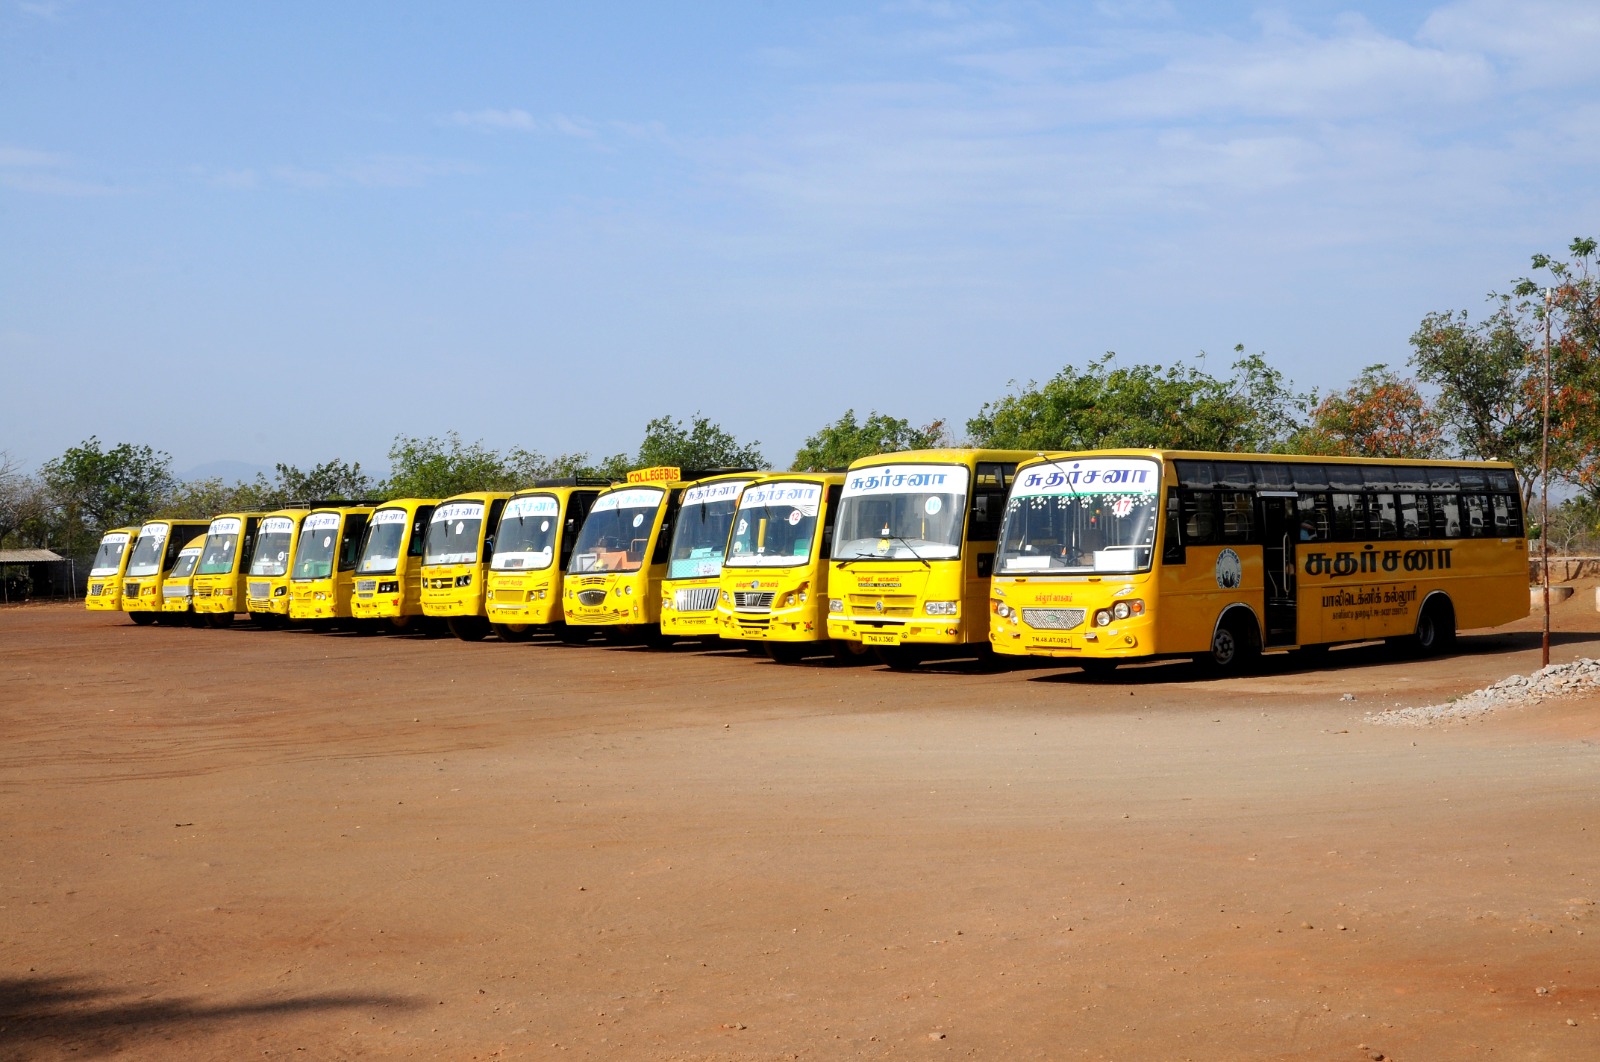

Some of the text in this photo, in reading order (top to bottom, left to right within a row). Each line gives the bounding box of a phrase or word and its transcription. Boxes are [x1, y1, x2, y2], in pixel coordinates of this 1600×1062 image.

[664, 468, 679, 480] BUS
[850, 468, 948, 492] சுதர்சனா
[1024, 463, 1151, 490] சுதர்சனா
[686, 485, 738, 501] சுதர்சனா
[744, 484, 817, 504] சுதர்சனா
[791, 512, 800, 521] 12
[1115, 500, 1131, 513] 17
[1304, 544, 1453, 579] சுதர்சனா
[1384, 585, 1417, 607] கல்லூரி
